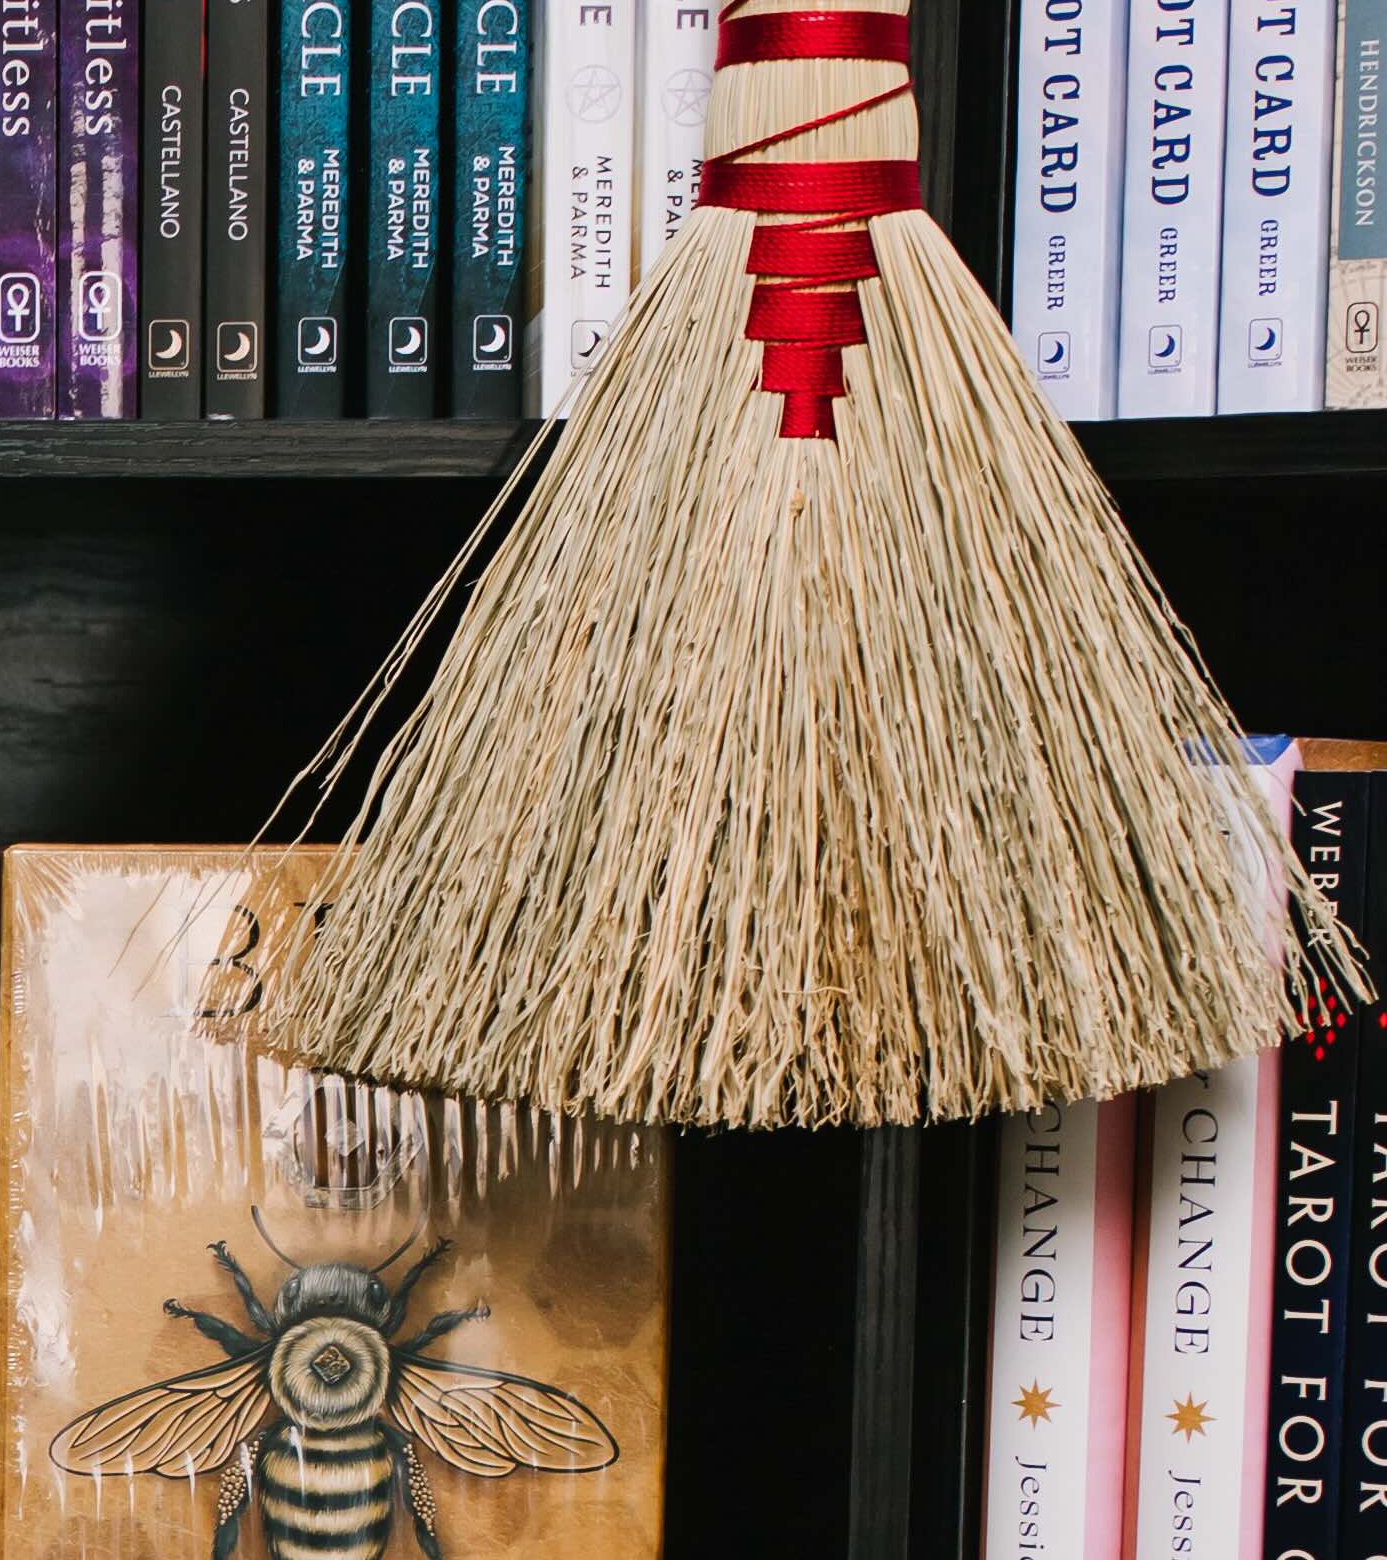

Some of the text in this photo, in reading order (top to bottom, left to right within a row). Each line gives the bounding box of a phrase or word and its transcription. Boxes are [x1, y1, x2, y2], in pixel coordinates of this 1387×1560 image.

[159, 86, 182, 238] CASTELLANO
[1249, 56, 1296, 203] CARD
[1255, 219, 1278, 296] GREER
[1283, 1099, 1338, 1334] TAROT
[1275, 1376, 1327, 1509] FOR
